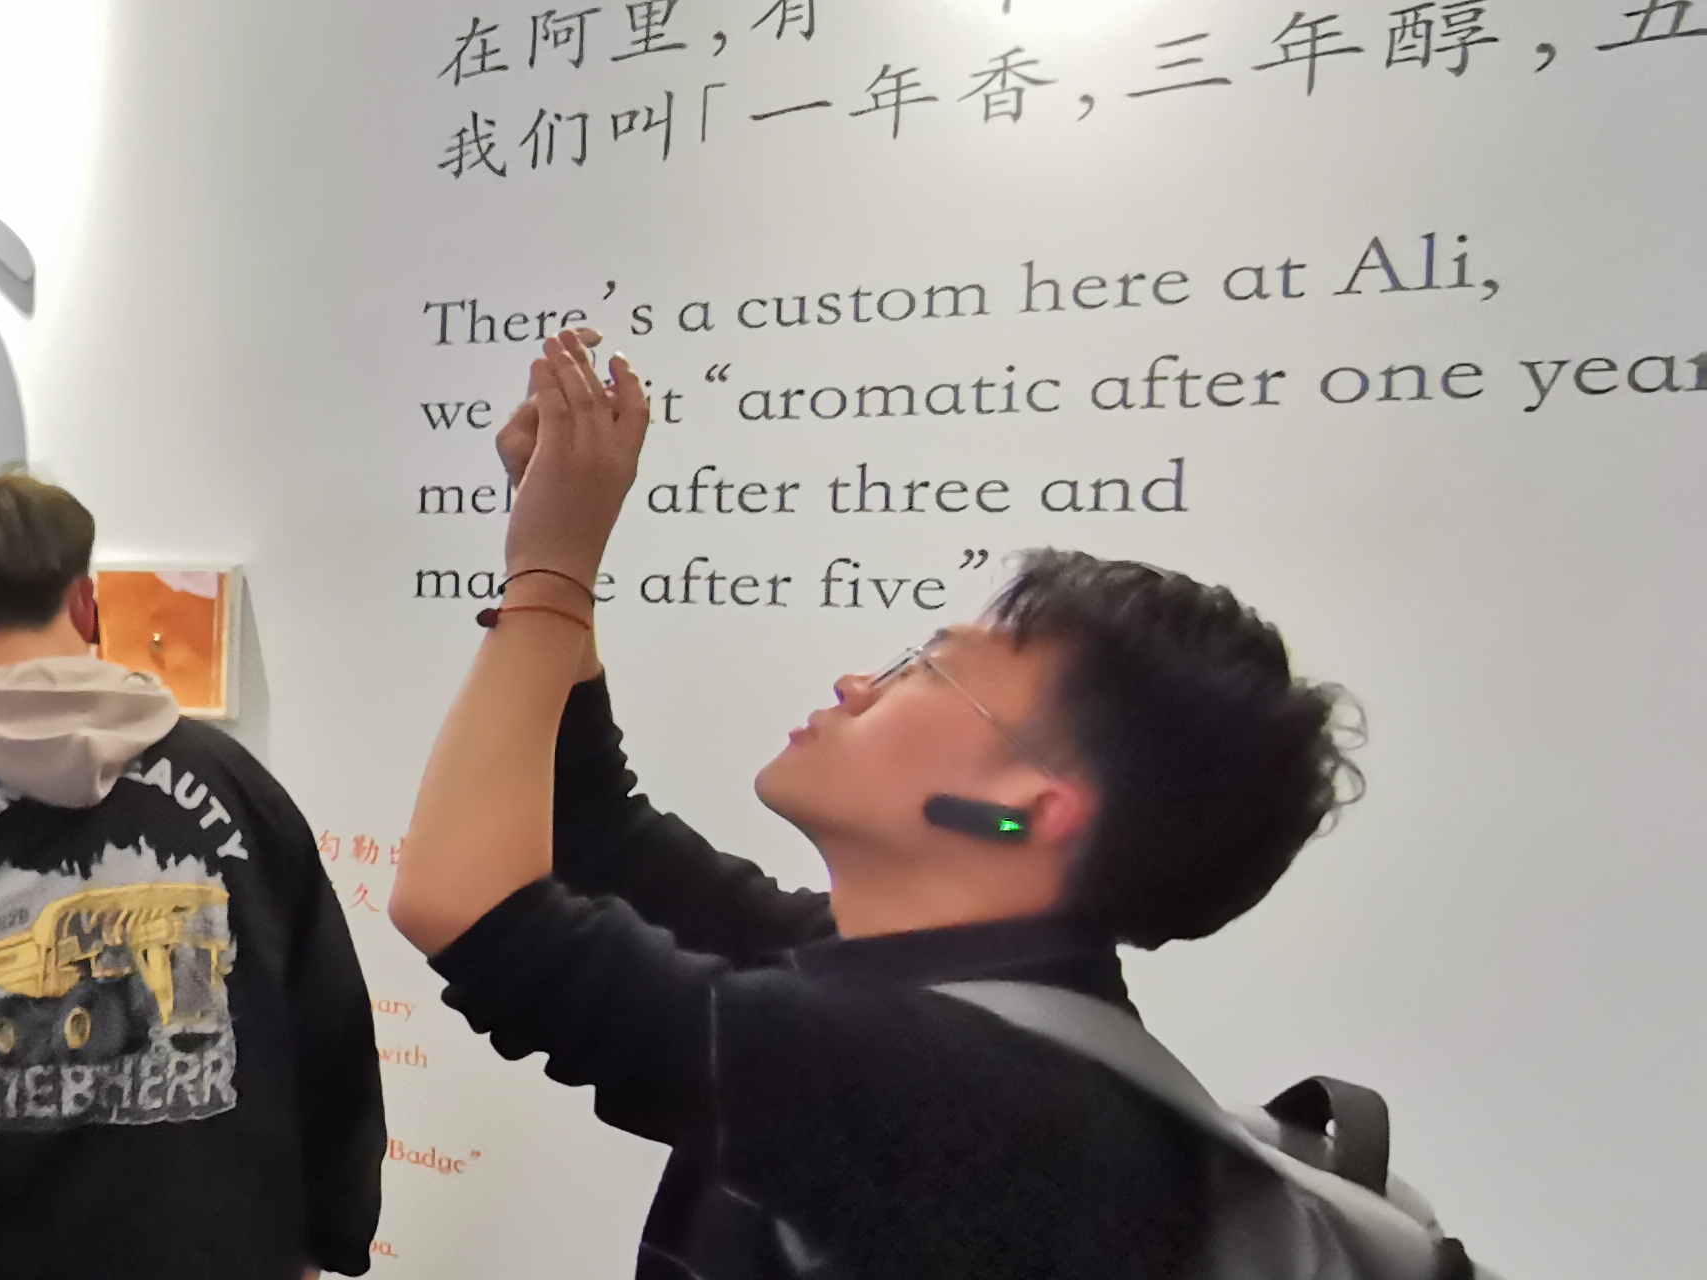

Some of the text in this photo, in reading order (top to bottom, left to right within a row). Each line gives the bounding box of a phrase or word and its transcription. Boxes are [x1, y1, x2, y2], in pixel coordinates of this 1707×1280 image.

[679, 296, 715, 332] a
[737, 282, 990, 329] custom
[1017, 260, 1190, 313] here
[1223, 257, 1307, 301] at
[1333, 231, 1500, 301] Ali,
[420, 399, 492, 429] we
[644, 380, 684, 424] it
[705, 363, 1061, 420] “aromatic
[1091, 355, 1287, 410] after
[1320, 361, 1485, 405] one
[418, 457, 1189, 514] mel after three and
[640, 556, 792, 606] after
[819, 549, 989, 611] five”
[121, 757, 249, 860] AUTY
